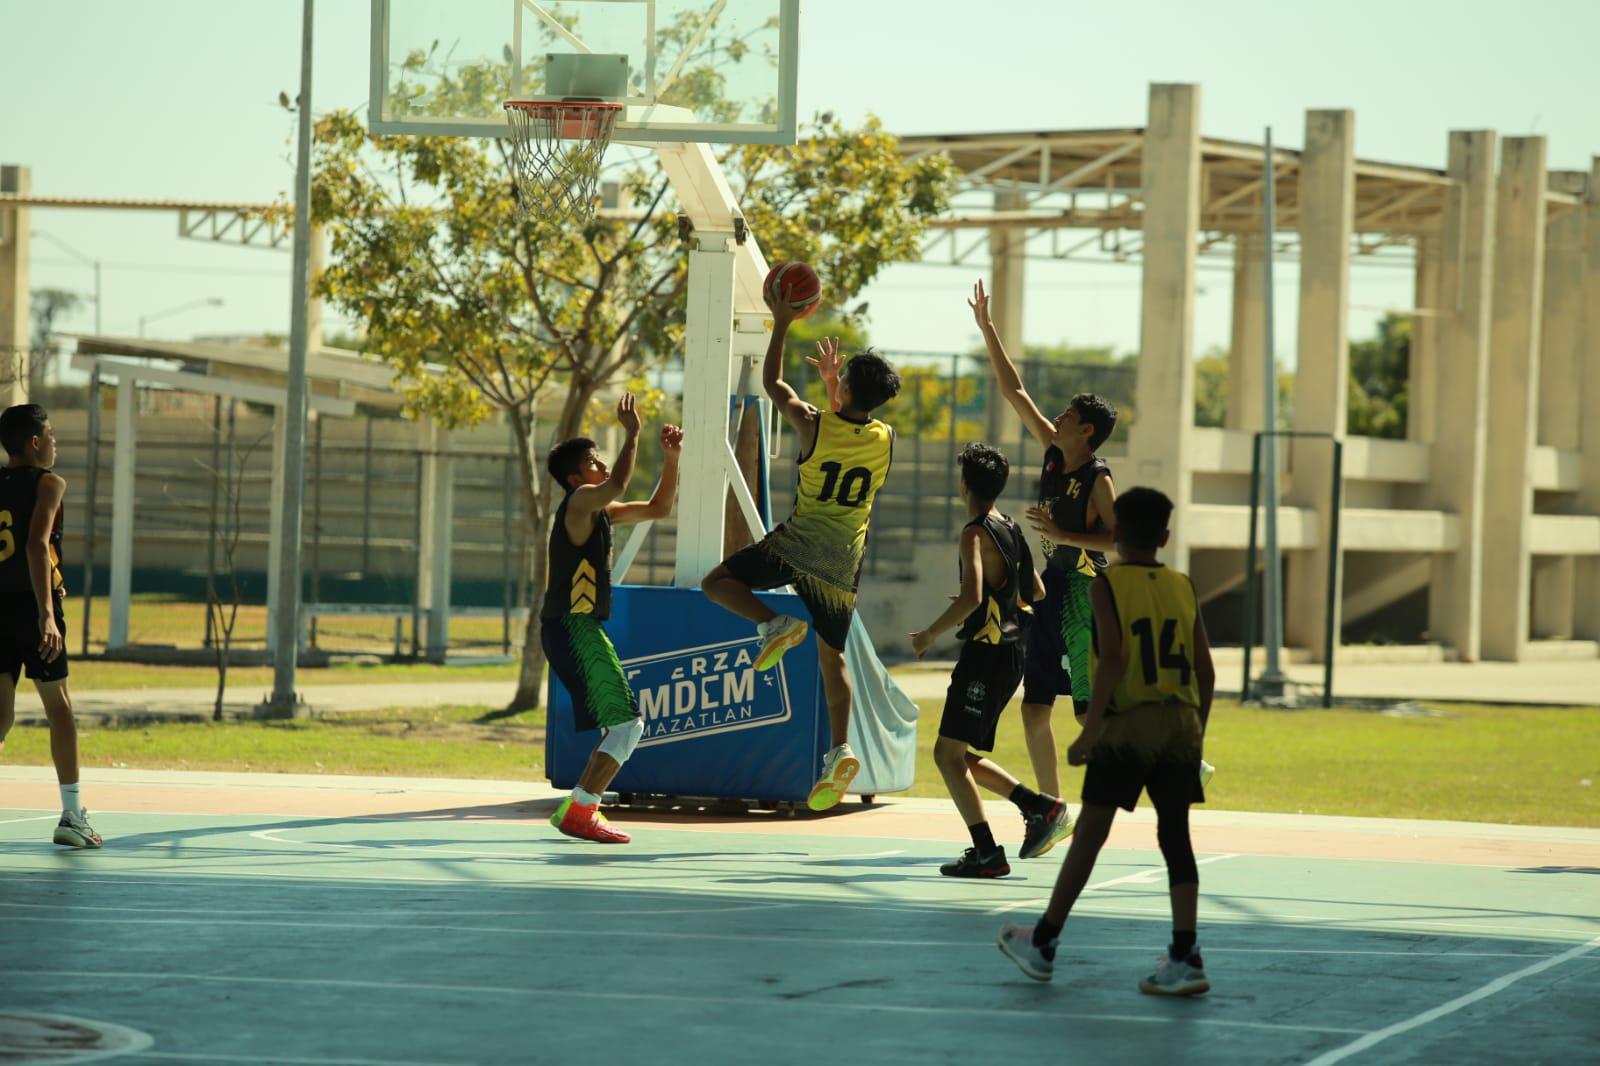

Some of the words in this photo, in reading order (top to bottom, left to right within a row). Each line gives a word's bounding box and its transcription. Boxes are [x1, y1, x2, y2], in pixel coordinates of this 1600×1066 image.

[816, 461, 872, 507] 10
[1130, 617, 1191, 686] 14
[641, 704, 752, 737] MAZATLAN
